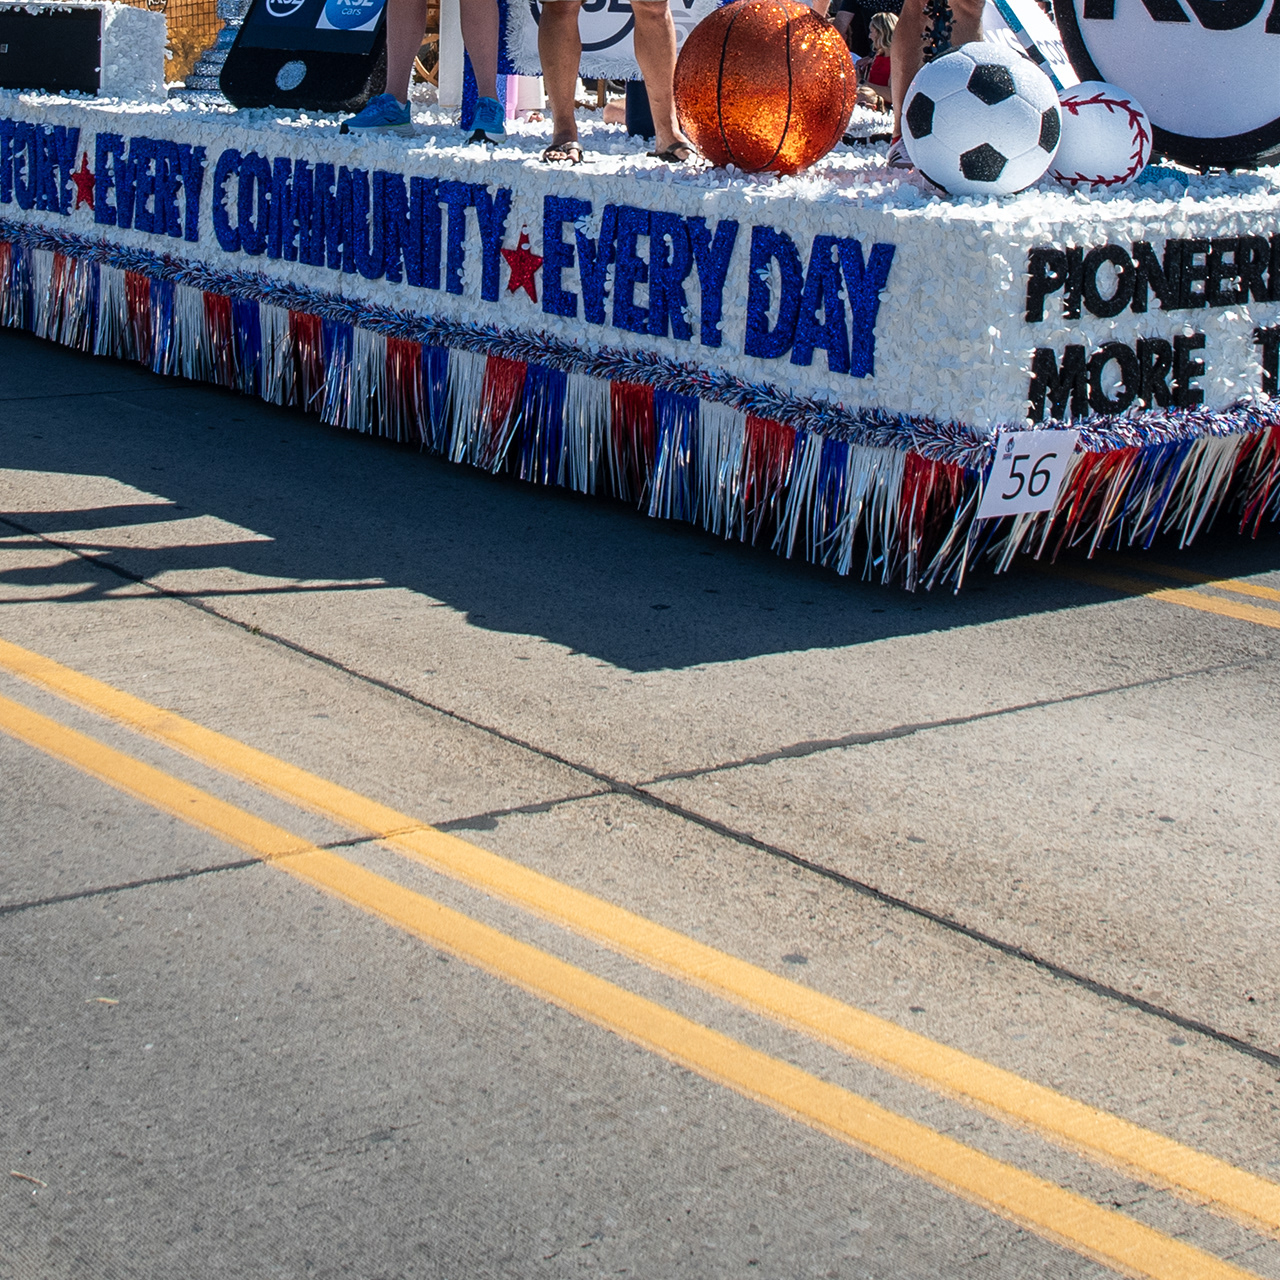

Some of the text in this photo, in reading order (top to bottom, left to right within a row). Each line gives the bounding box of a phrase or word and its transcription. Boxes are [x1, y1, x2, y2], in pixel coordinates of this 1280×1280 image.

[341, 6, 362, 16] cars
[94, 131, 207, 243] EVERY
[212, 147, 512, 303] COMMUNITY
[541, 194, 740, 348] EVERY
[743, 224, 896, 378] DAY
[1026, 332, 1207, 421] MORE
[1001, 452, 1058, 501] 56
